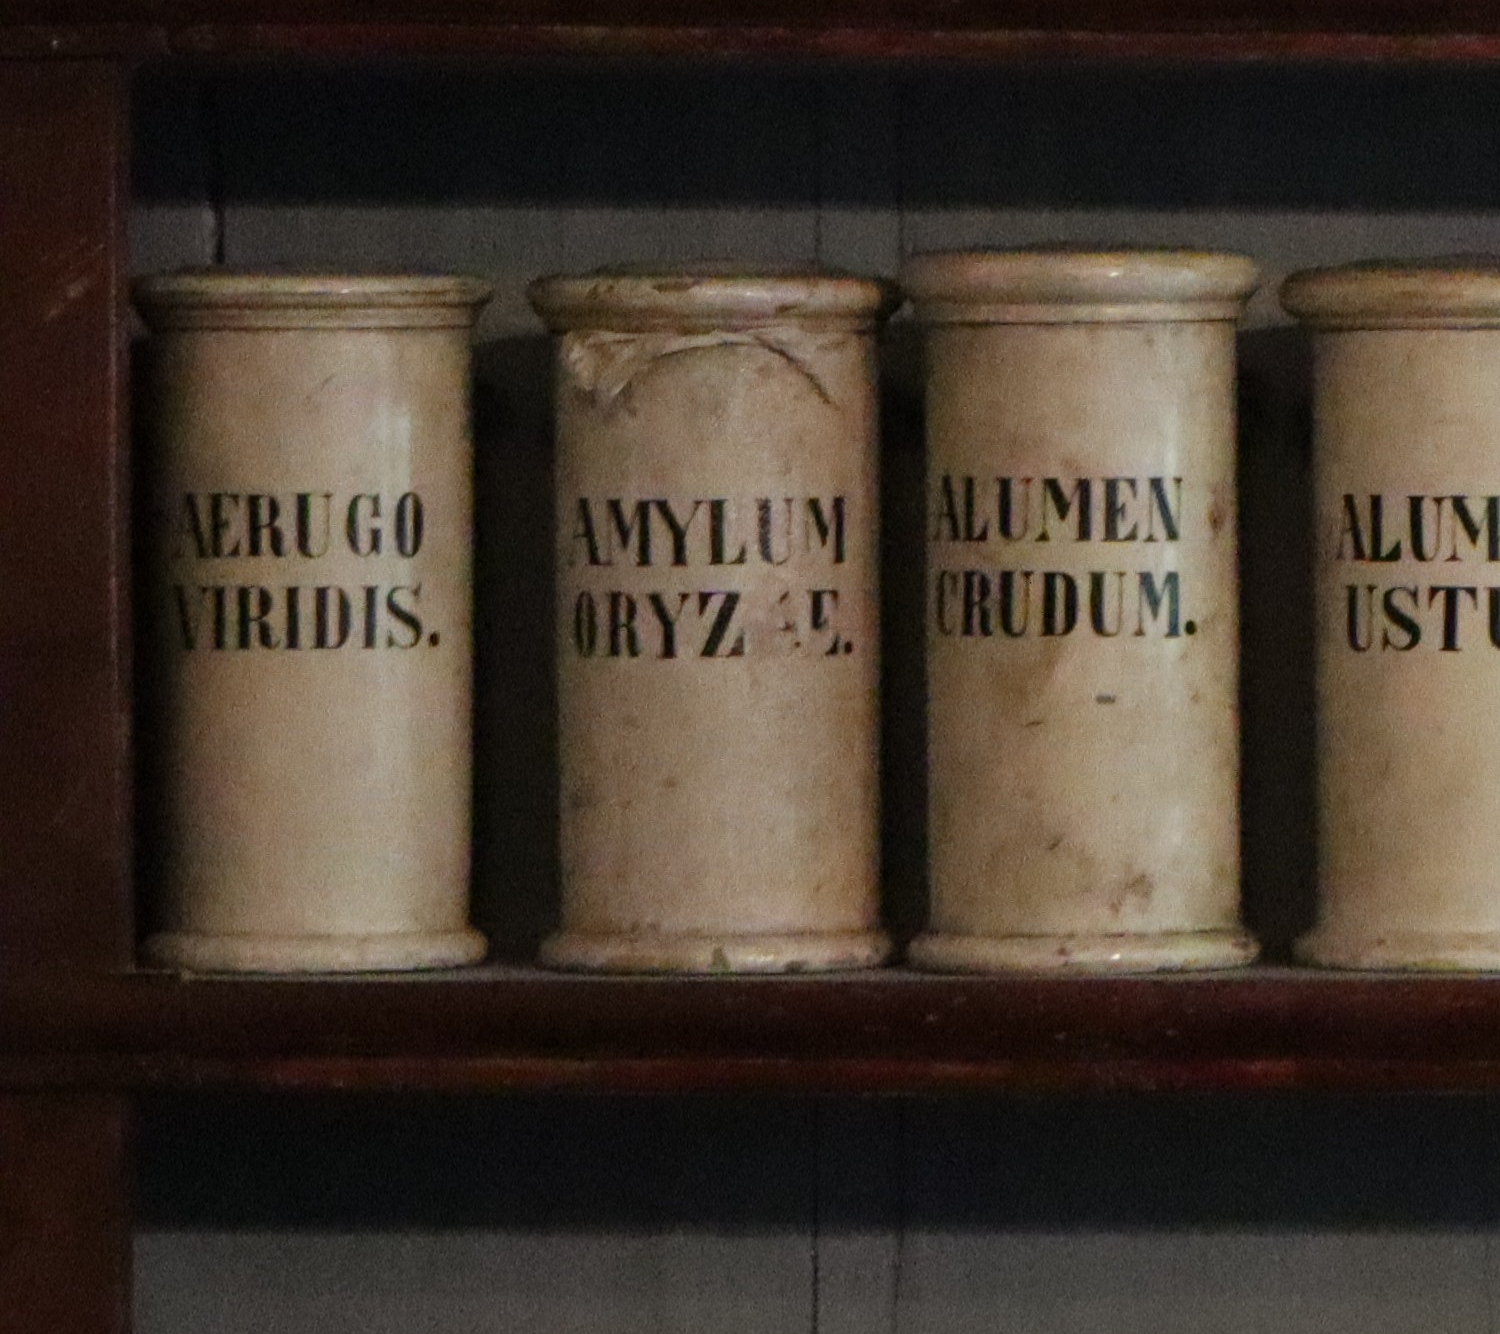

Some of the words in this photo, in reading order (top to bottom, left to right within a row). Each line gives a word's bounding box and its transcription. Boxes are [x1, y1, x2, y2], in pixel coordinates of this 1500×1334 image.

[573, 496, 847, 567] AMYLUM
[930, 476, 1183, 543] ALUMEN
[937, 571, 1197, 638] CRUDUM.
